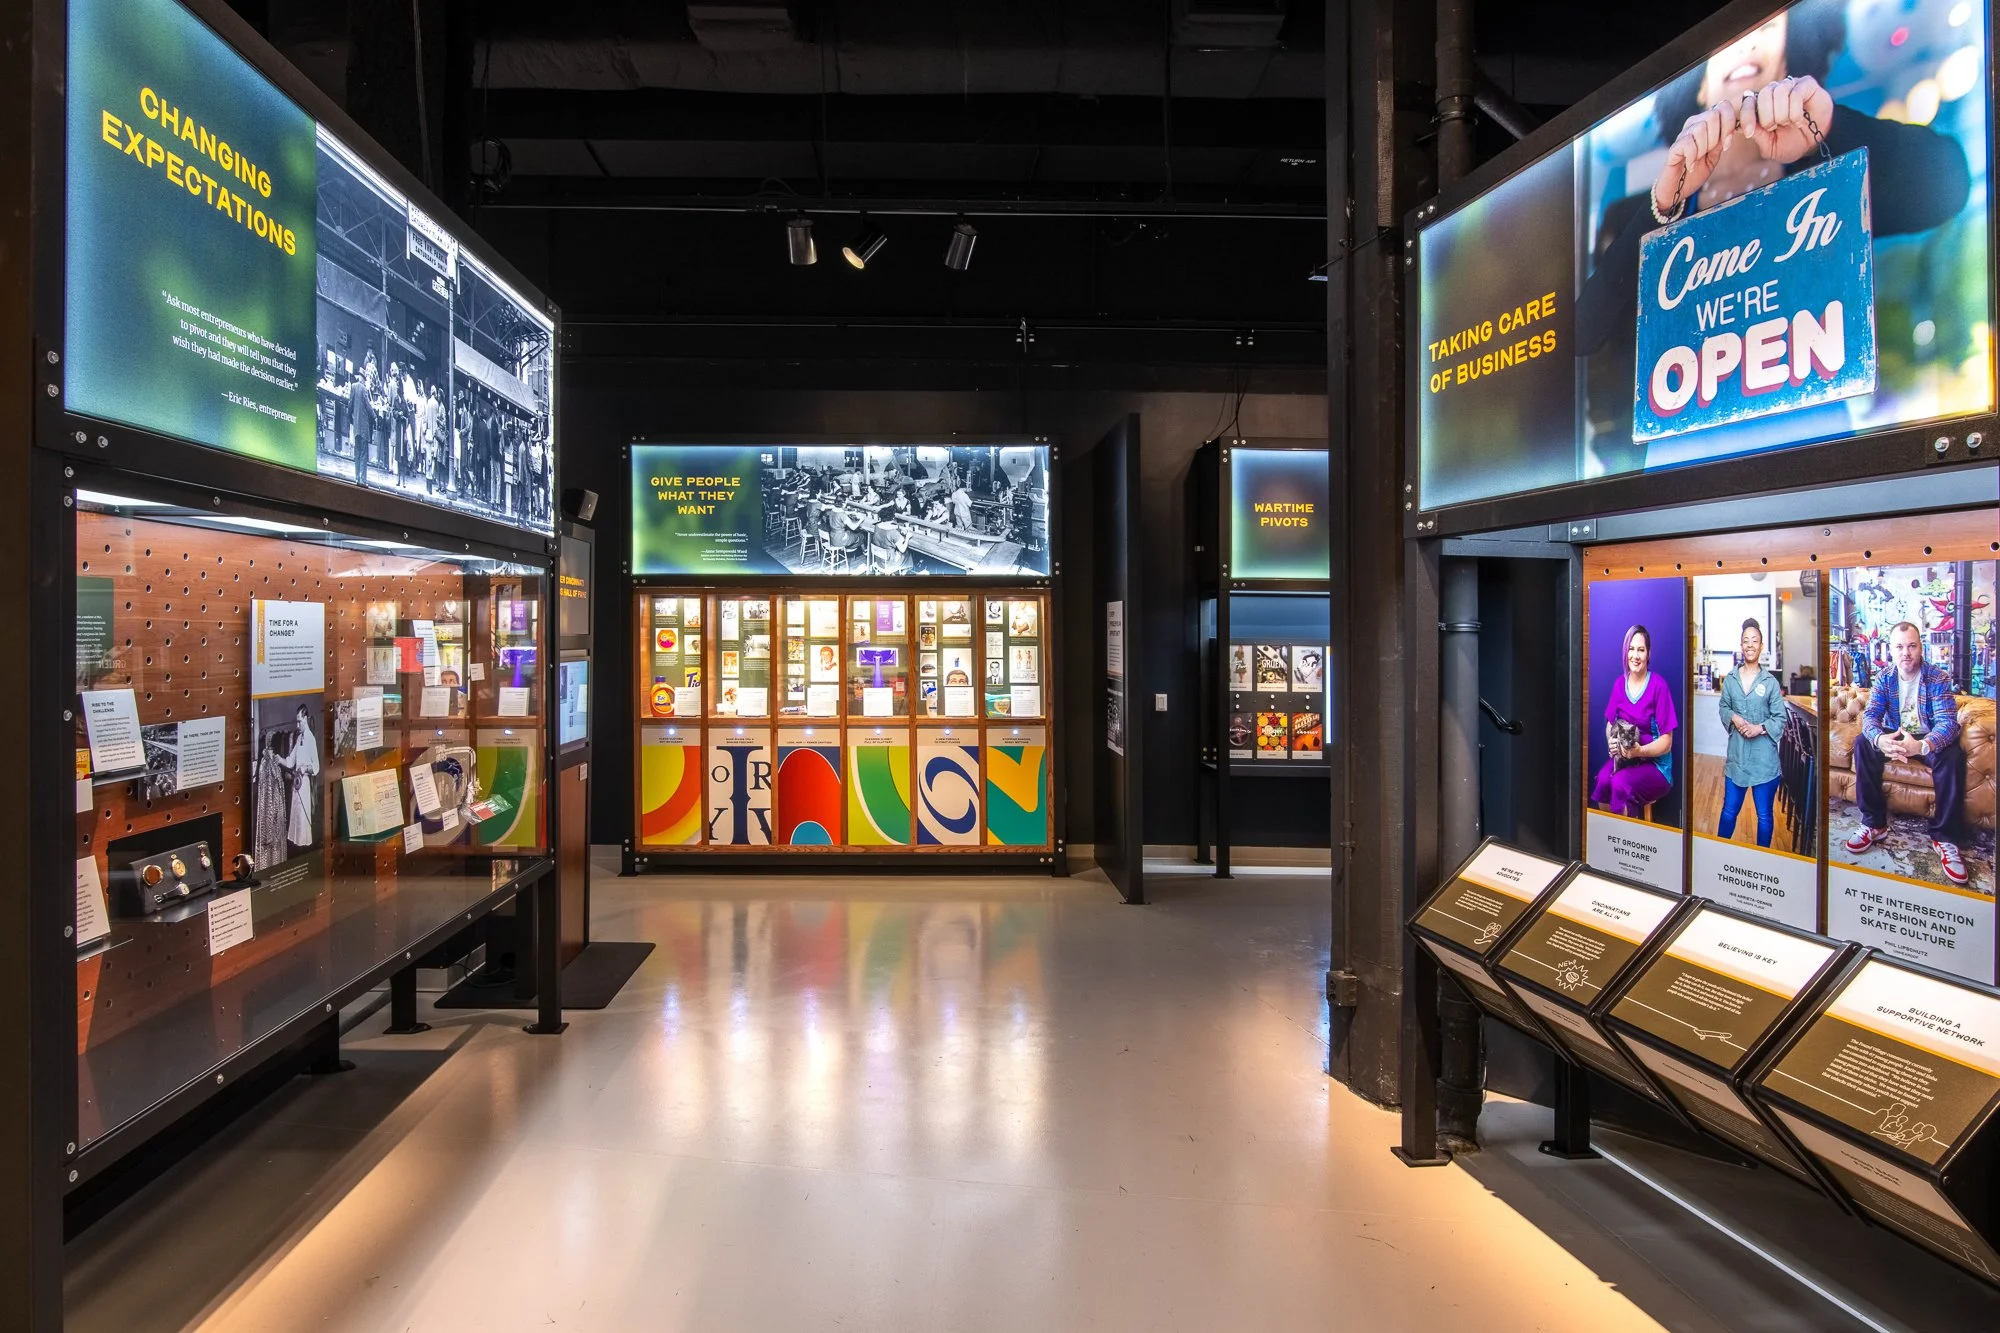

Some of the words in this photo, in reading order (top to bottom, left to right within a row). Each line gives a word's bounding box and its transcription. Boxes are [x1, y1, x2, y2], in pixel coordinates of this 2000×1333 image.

[140, 87, 272, 198] CHANGING
[102, 109, 296, 256] EXPECTATIONS
[1658, 235, 1762, 311] Come
[1774, 187, 1842, 264] In
[1696, 279, 1780, 332] WE'RE
[162, 290, 180, 308] “Ask
[181, 302, 200, 317] most
[200, 311, 246, 338] entrepreneurs
[247, 332, 260, 344] who
[261, 336, 274, 350] have
[275, 343, 296, 360] decided
[1428, 320, 1492, 362] TAKING
[1498, 292, 1556, 334] CARE
[172, 336, 190, 350] wish
[191, 342, 207, 358] they
[208, 347, 220, 361] had
[221, 355, 240, 370] made
[240, 361, 250, 374] the
[250, 366, 275, 384] decision
[180, 319, 188, 330] to
[189, 324, 207, 338] pivot
[208, 332, 221, 344] and
[222, 336, 236, 353] they
[237, 345, 249, 357] will
[250, 350, 260, 360] tell
[260, 354, 272, 366] you
[272, 358, 284, 372] that
[284, 364, 296, 378] they
[1430, 368, 1452, 394] OF
[1457, 330, 1556, 384] BUSINESS
[1649, 300, 1845, 415] OPEN
[243, 396, 258, 412] Ries,
[259, 404, 296, 424] entrepreneur
[650, 477, 682, 487] GIVE
[686, 477, 740, 487] PEOPLE
[658, 491, 694, 500] WHAT
[698, 491, 735, 500] THEY
[678, 505, 716, 514] WANT
[1254, 503, 1314, 514] WARTIME
[1260, 518, 1308, 527] PIVOTS
[1608, 835, 1620, 844] PET
[1622, 839, 1658, 854] GROOMING
[1614, 846, 1630, 856] WITH
[1631, 852, 1650, 862] CARE
[1496, 872, 1520, 882] ADVOCATES
[1718, 873, 1758, 890] THROUGH
[1760, 885, 1785, 898] FOOD
[1724, 864, 1779, 884] CONNECTING
[1592, 900, 1631, 917] CINCINNATIANS
[1844, 888, 1858, 898] AT
[1861, 891, 1882, 904] THE
[1886, 898, 1974, 927] INTERSECTION
[1860, 904, 1874, 914] OF
[1878, 908, 1926, 928] FASHION
[1930, 922, 1956, 936] AND
[1860, 916, 1896, 934] SKATE
[1900, 928, 1956, 950] CULTURE
[1718, 942, 1754, 958] BELIEVING
[1762, 956, 1778, 966] KEY
[1876, 1006, 1935, 1030] SUPPORTIVE
[1936, 1026, 1985, 1046] NETWORK
[1908, 1007, 1952, 1026] BUILDING
